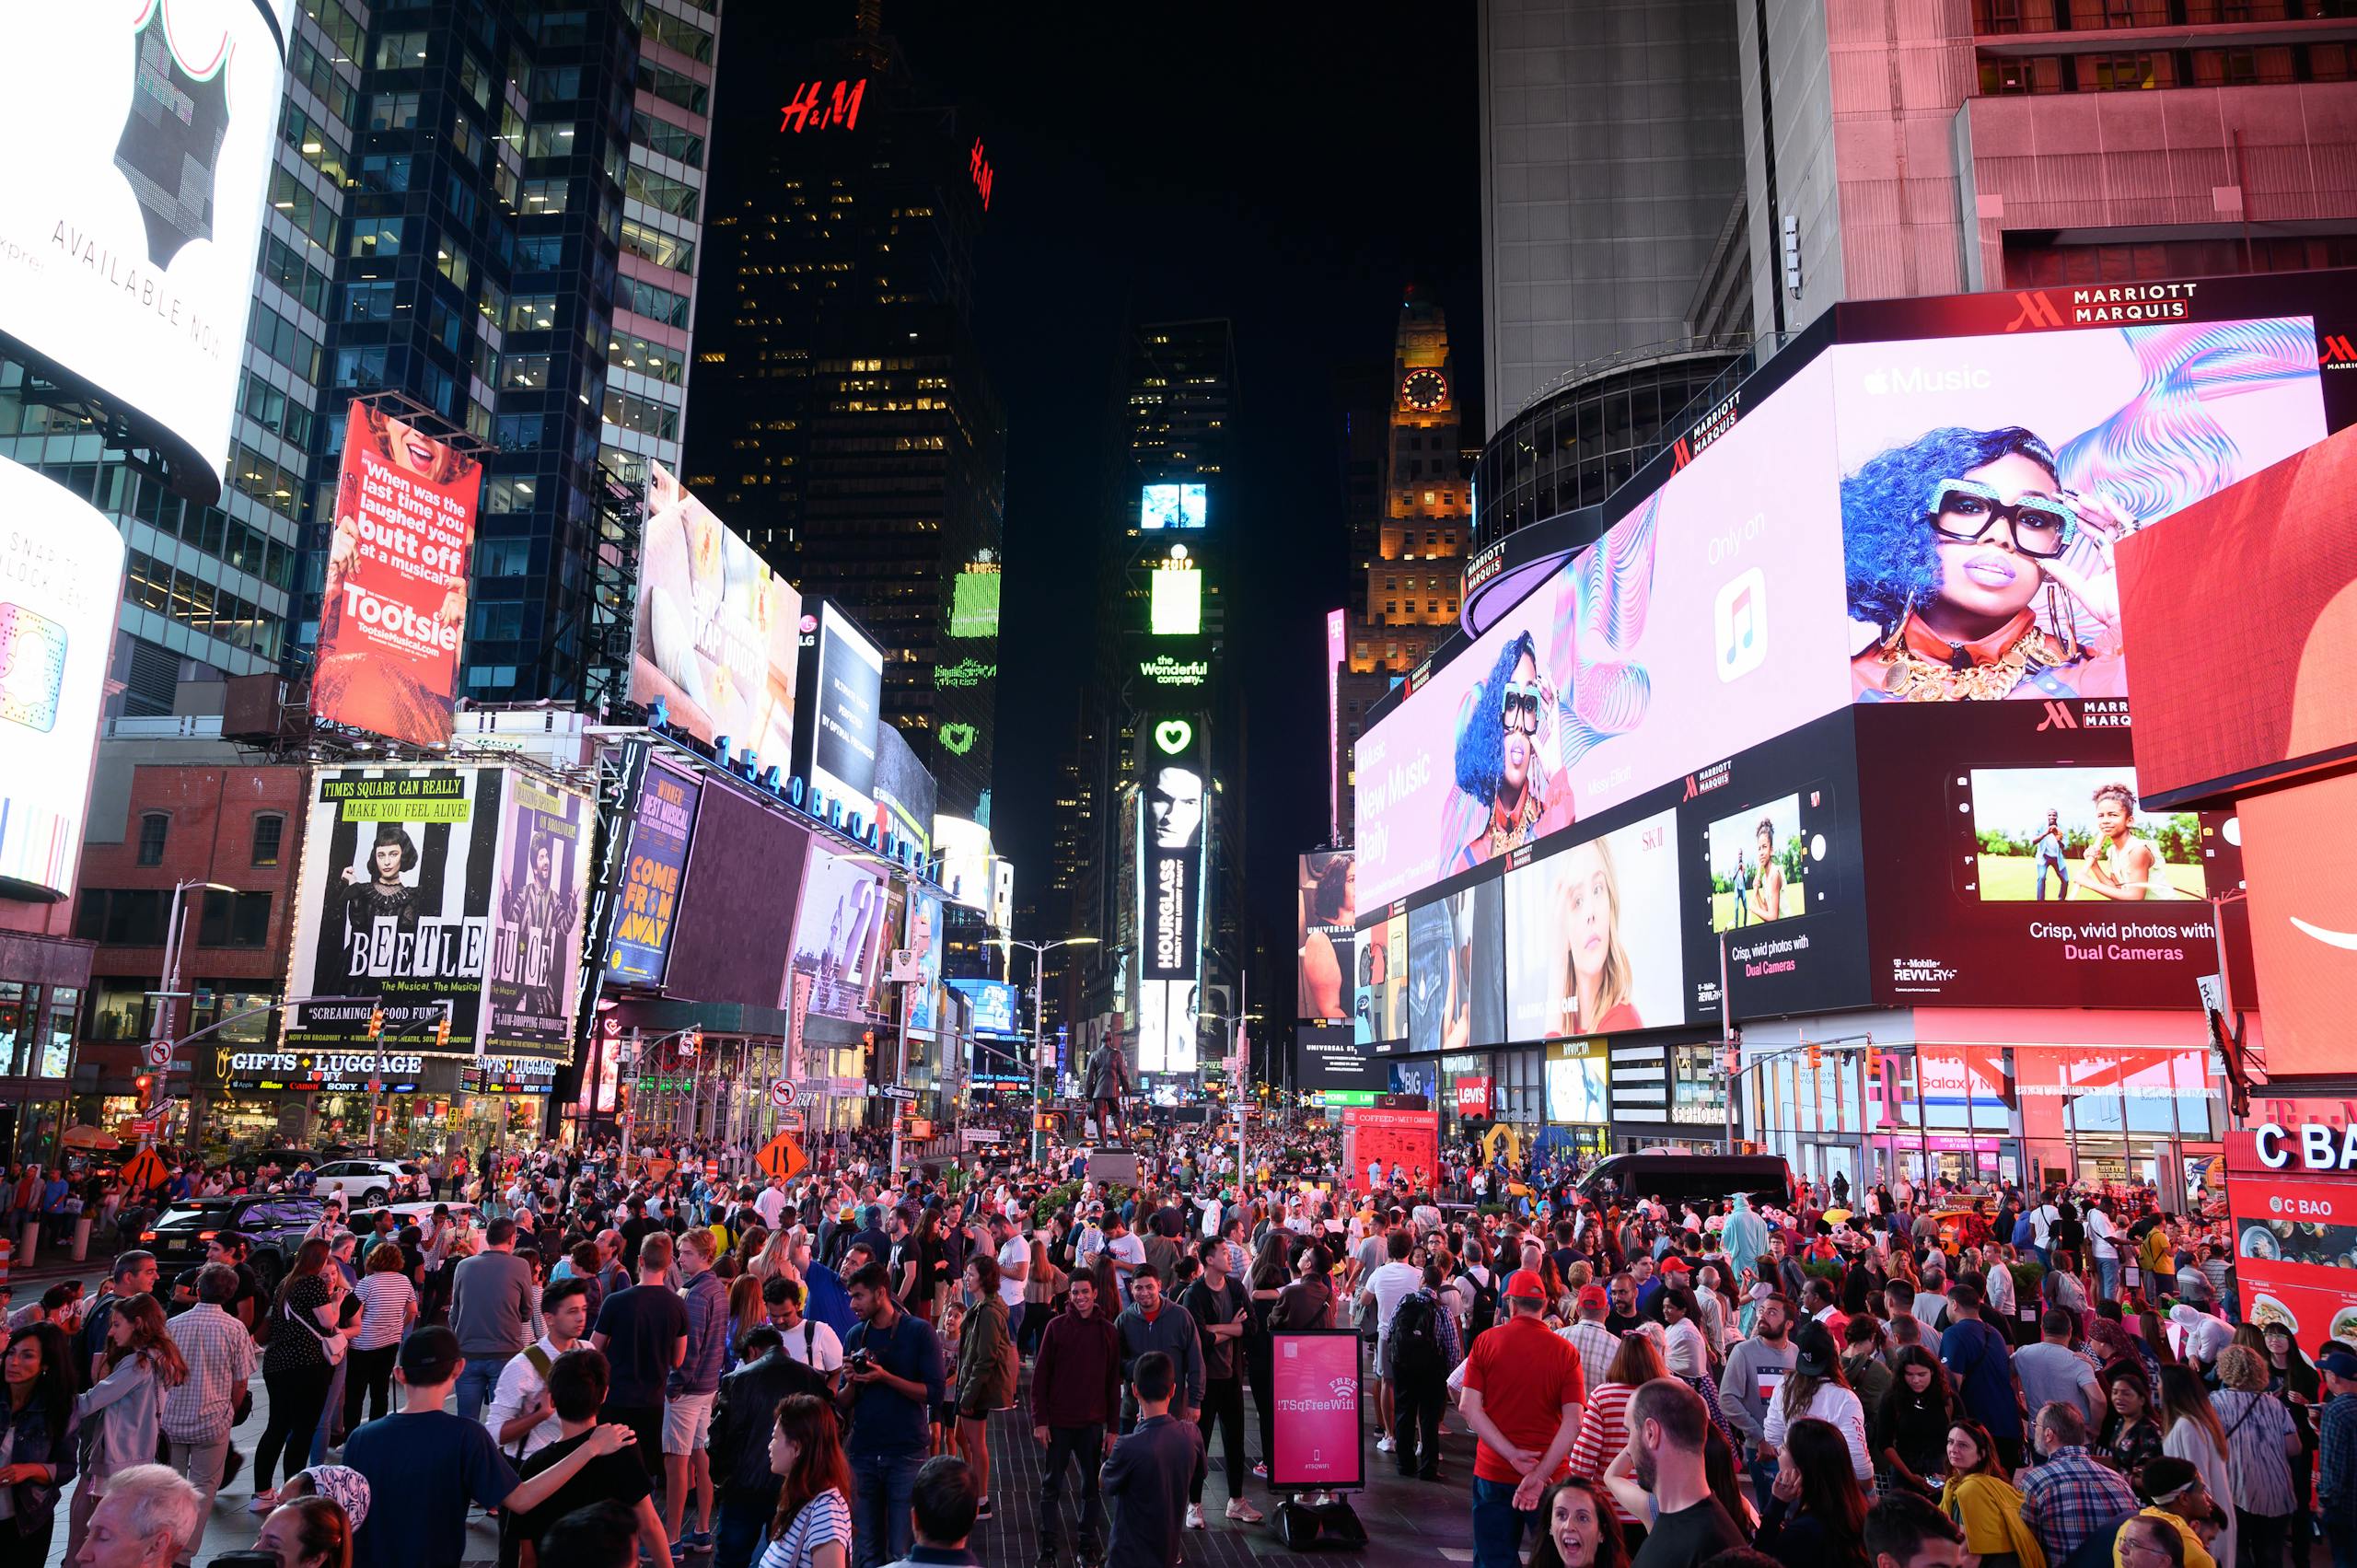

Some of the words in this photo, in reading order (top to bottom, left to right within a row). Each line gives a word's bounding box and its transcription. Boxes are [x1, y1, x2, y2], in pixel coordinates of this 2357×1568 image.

[781, 78, 866, 134] H&M
[970, 137, 993, 213] H&M
[52, 220, 180, 326] AVAILABLE
[2073, 283, 2198, 305] MARRIOTT
[2075, 302, 2185, 322] MARQUIS
[1893, 366, 1991, 394] Music
[1693, 390, 1741, 440] MARRIOTT
[1694, 412, 1736, 455] MARQUIS
[363, 474, 392, 502] last
[398, 491, 433, 518] time
[436, 511, 464, 533] you
[413, 485, 440, 506] was
[444, 496, 465, 517] the
[360, 493, 426, 534] laughed
[427, 526, 462, 549] your
[358, 510, 418, 559] butt
[422, 545, 461, 575] off
[1709, 524, 1741, 565] Only
[1745, 512, 1765, 541] on
[360, 543, 376, 558] at
[378, 551, 388, 563] a
[1468, 541, 1505, 578] MARRIOTT
[1162, 559, 1193, 570] 2019
[1468, 560, 1501, 592] MARQUIS
[343, 581, 457, 651] Tootsie
[357, 621, 440, 657] TootsieMusical.com
[798, 635, 815, 646] LG
[1140, 662, 1207, 675] Wonderful
[1157, 655, 1174, 665] the
[717, 736, 804, 806] 1540
[1699, 761, 1731, 780] MARRIOTT
[324, 783, 354, 797] TIMES
[356, 782, 396, 797] SQUARE
[399, 781, 420, 795] CAN
[422, 779, 461, 795] REALLY
[657, 779, 684, 807] WINNER!
[1359, 784, 1386, 826] New
[1388, 748, 1430, 807] Music
[1700, 774, 1729, 792] MARQUIS
[347, 804, 377, 818] MAKE
[381, 804, 401, 818] YOU
[404, 804, 430, 818] FEEL
[434, 804, 467, 818] ALIVE!
[540, 815, 547, 828] ON
[644, 794, 660, 816] BEST
[661, 802, 689, 830] MUSICAL
[1359, 820, 1388, 867] Daily
[631, 855, 679, 894] COME
[1158, 858, 1175, 969] HOURGLASS
[617, 912, 668, 947] AWAY
[1307, 924, 1355, 935] UNIVERSAL
[2030, 922, 2077, 941] Crisp,
[2080, 922, 2118, 938] vivid
[2121, 922, 2177, 941] photos
[2182, 922, 2214, 938] with
[348, 921, 488, 978] BEETLE
[1732, 946, 1751, 962] Crisp,
[1751, 942, 1768, 956] vivid
[1769, 939, 1793, 958] photos
[1794, 935, 1809, 950] with
[2064, 945, 2103, 960] Dual
[2107, 945, 2184, 960] Cameras
[1746, 962, 1761, 977] Dual
[1762, 959, 1795, 975] Cameras
[381, 981, 396, 992] The
[397, 981, 431, 992] Musical.
[434, 981, 449, 992] The
[1562, 995, 1578, 1013] ONE
[1563, 1042, 1590, 1056] INVICTA
[231, 1053, 297, 1071] GIFTS
[314, 1055, 423, 1074] LUGGAGE
[476, 1058, 506, 1074] GIFTS
[513, 1060, 557, 1076] LUGGAGE
[259, 1081, 283, 1089] Nikon
[289, 1082, 319, 1090] Canon
[322, 1072, 343, 1082] NY
[1404, 1072, 1421, 1094] BIG
[1922, 1077, 1975, 1095] Galaxy
[1360, 1114, 1395, 1122] COFFEED
[1670, 1108, 1724, 1124] SEPHORA
[2256, 1123, 2287, 1167] C
[2284, 1199, 2294, 1214] C
[2299, 1200, 2332, 1215] BAO
[1329, 1376, 1359, 1388] FREE
[1278, 1399, 1354, 1412] !TSqFreeWifi
